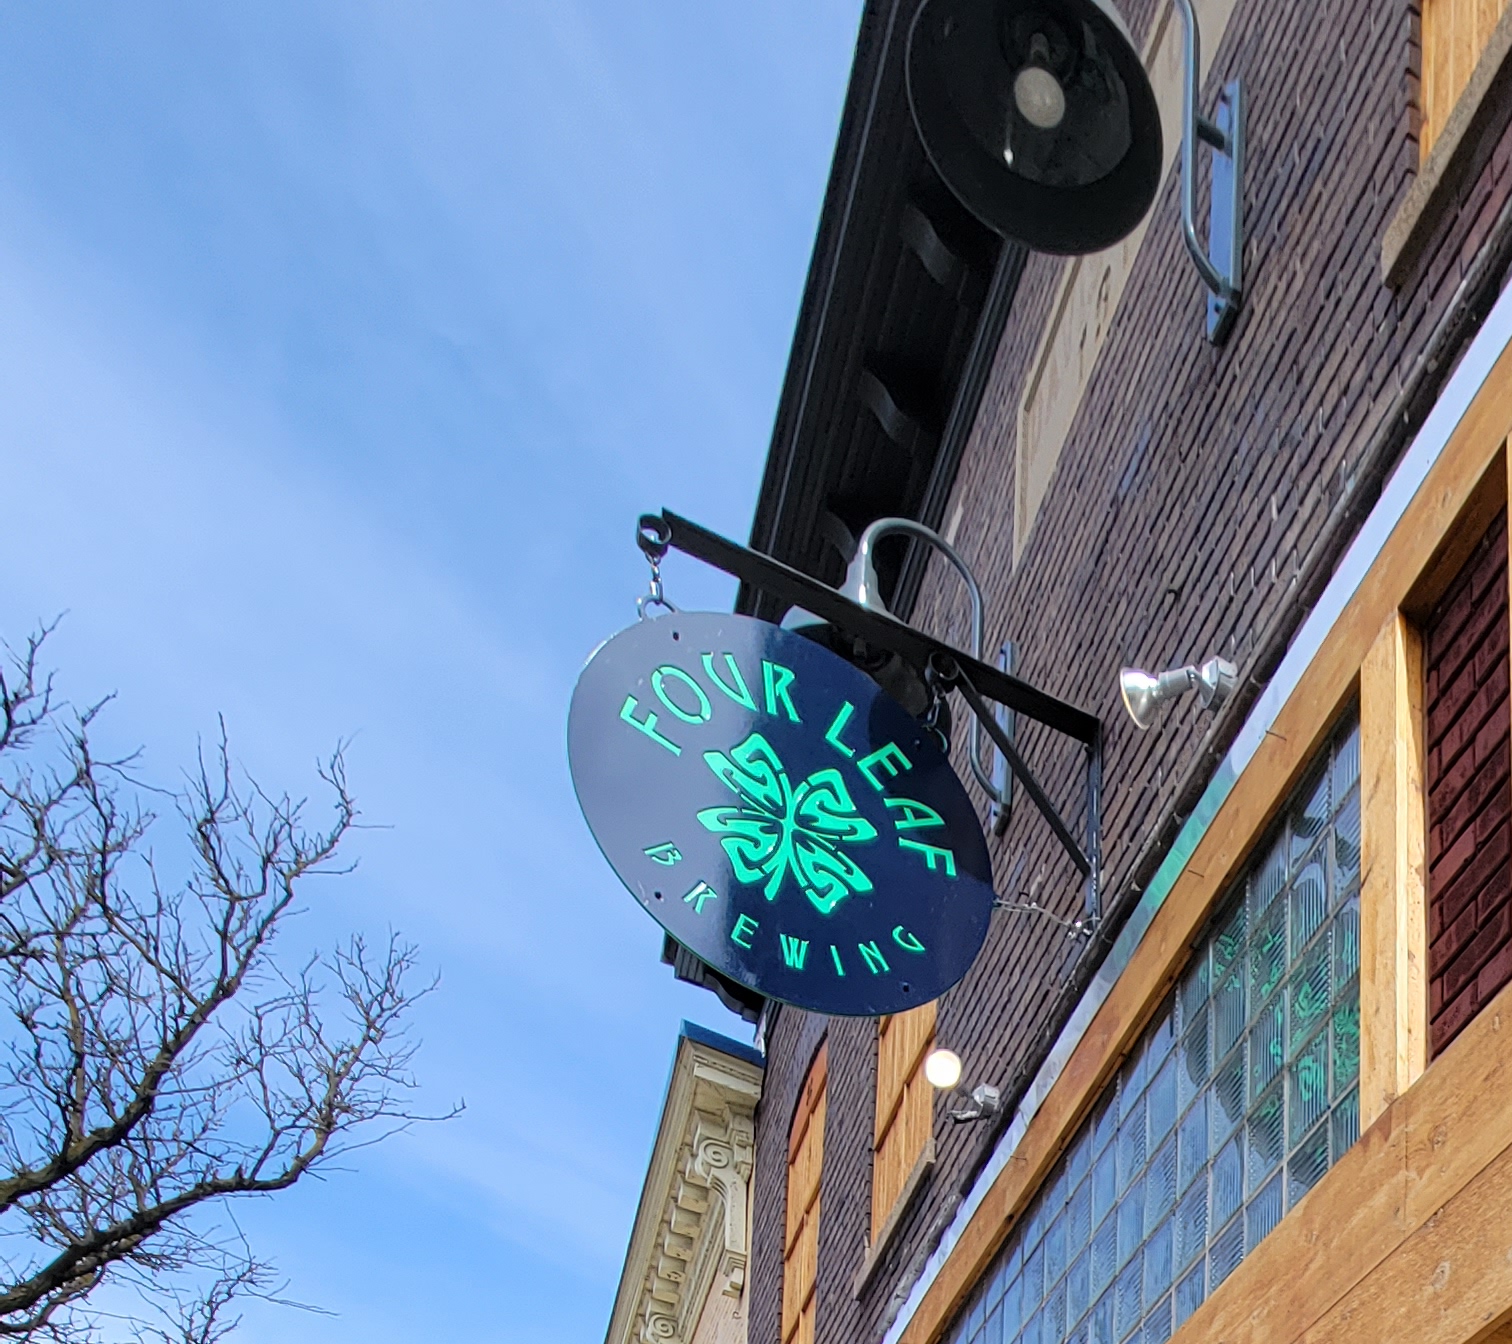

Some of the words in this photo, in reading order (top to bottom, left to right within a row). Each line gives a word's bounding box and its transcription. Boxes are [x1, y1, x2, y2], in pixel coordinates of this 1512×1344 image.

[620, 651, 801, 756] FOUR
[825, 701, 957, 878] LEAF
[643, 841, 926, 977] BREWING
